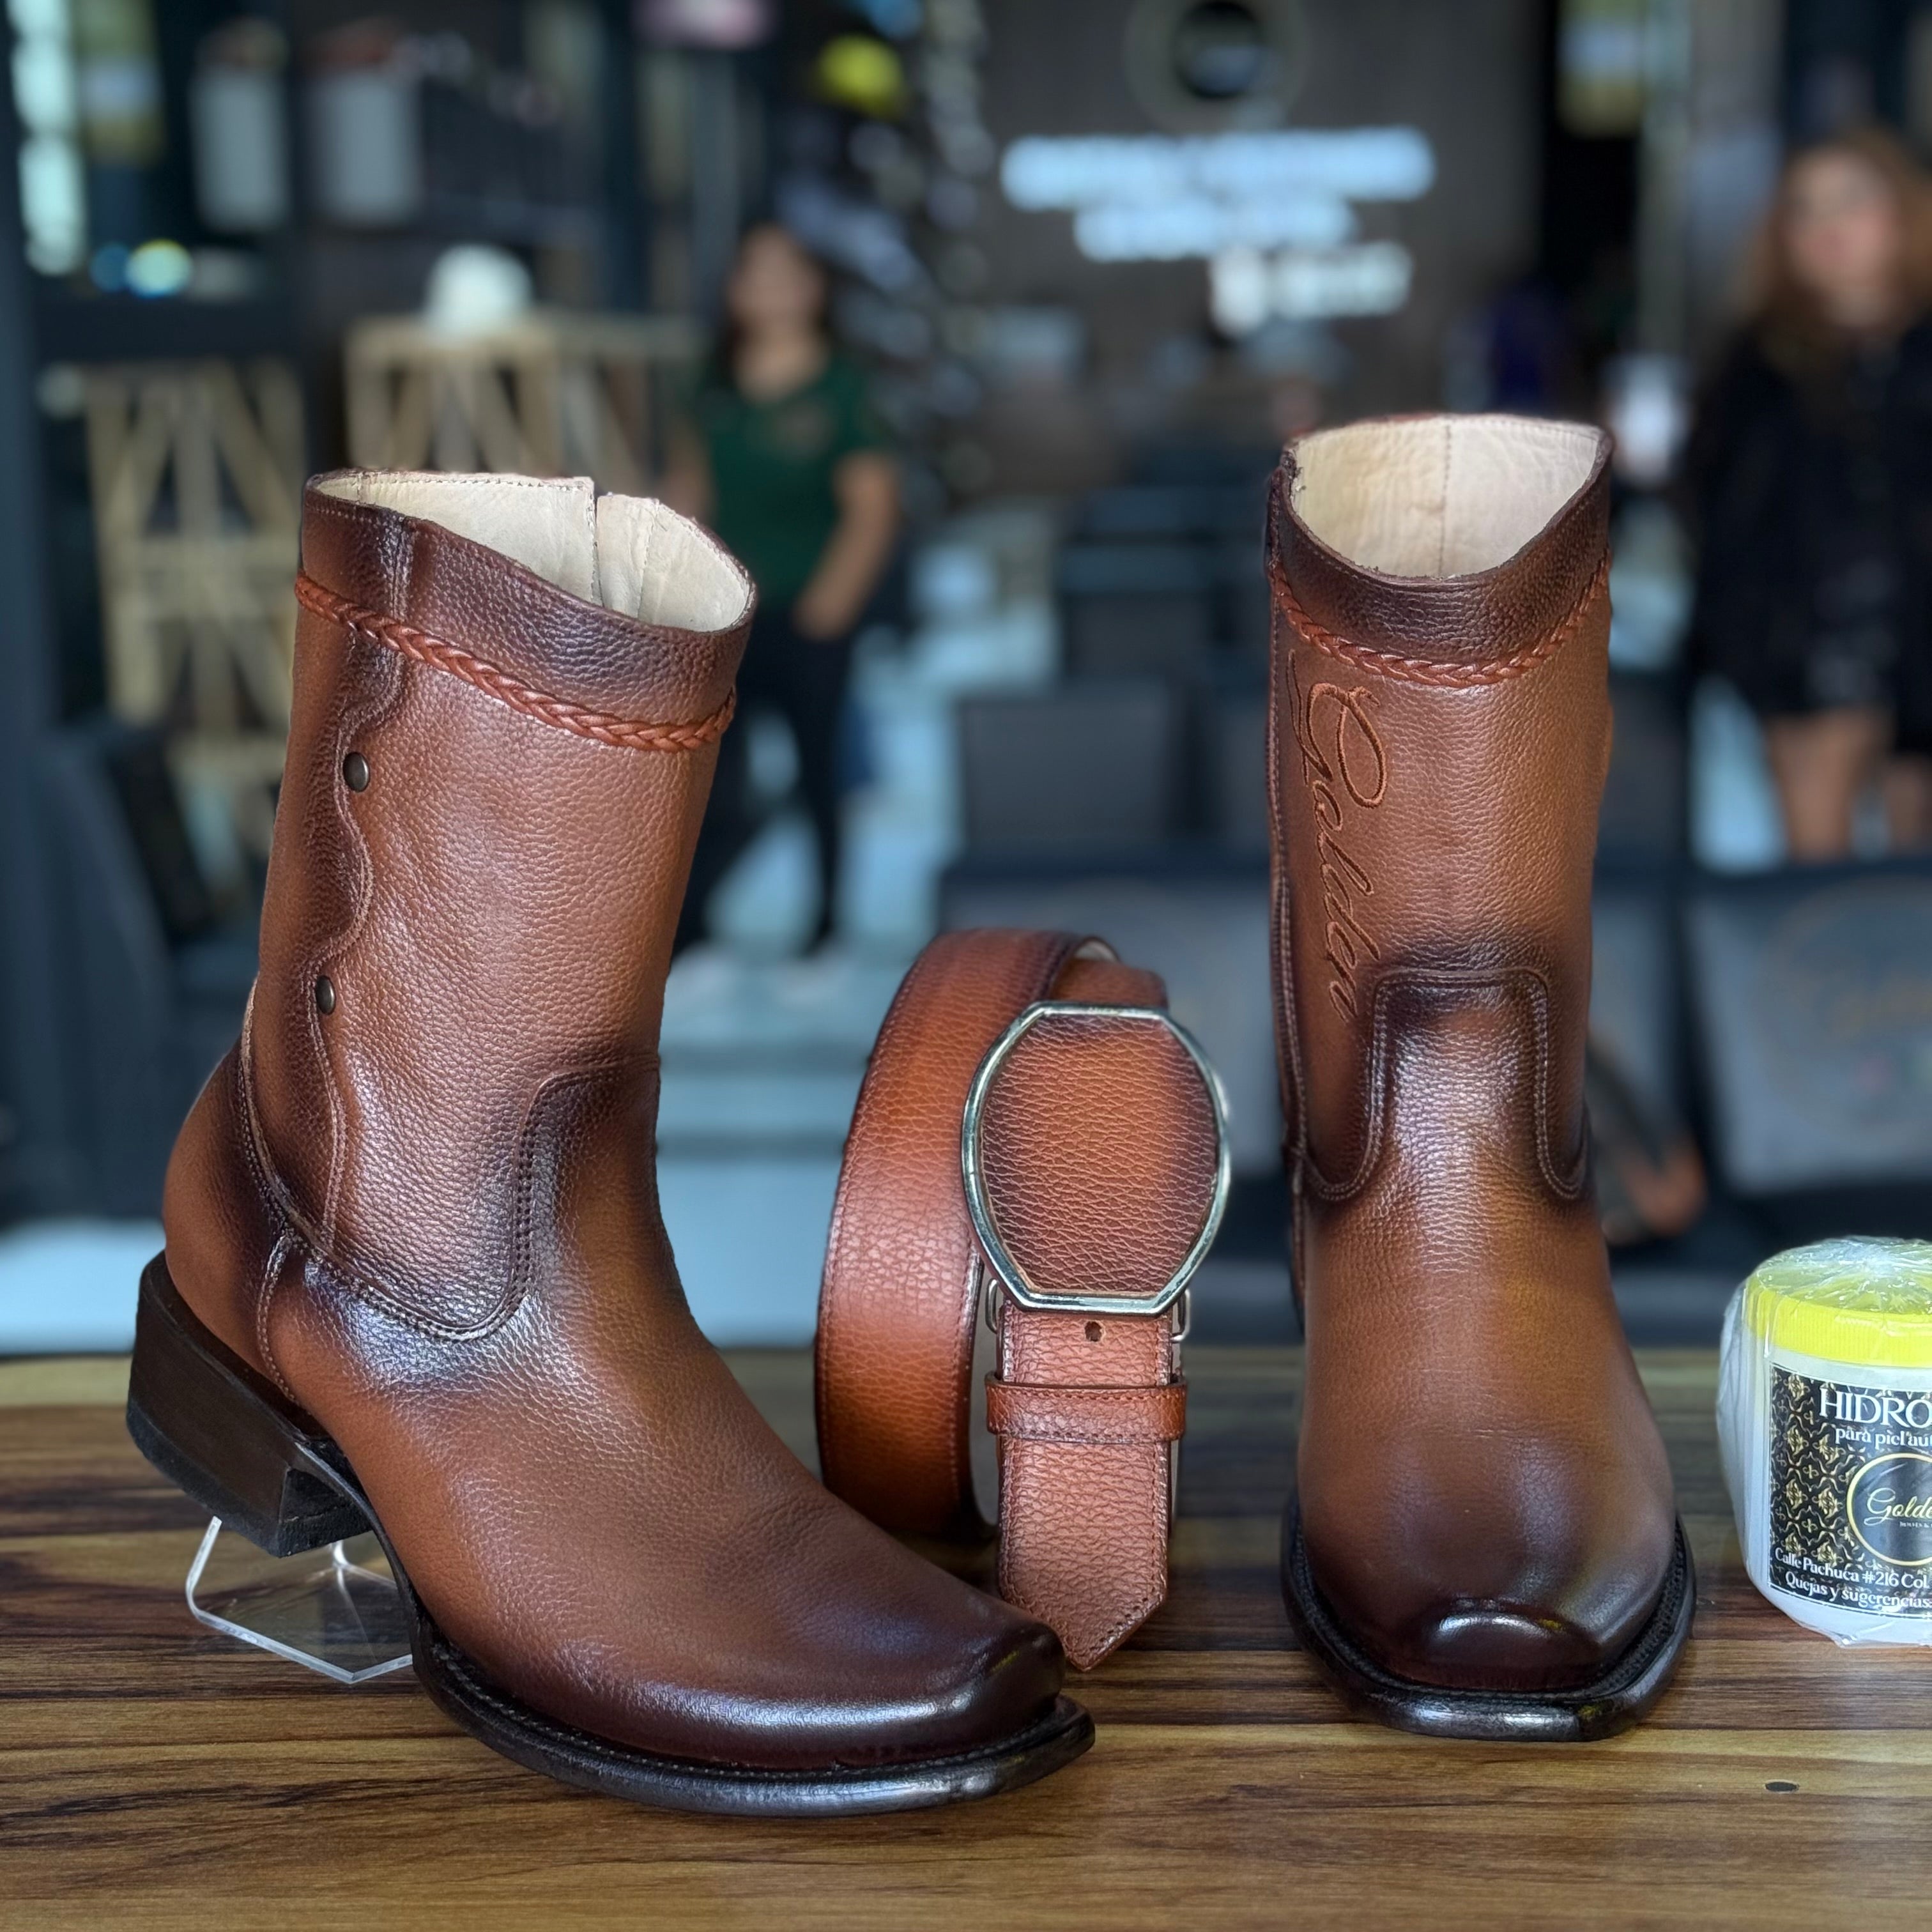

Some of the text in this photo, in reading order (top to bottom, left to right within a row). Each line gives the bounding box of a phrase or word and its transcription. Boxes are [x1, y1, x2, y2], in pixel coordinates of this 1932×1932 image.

[1286, 649, 1387, 1023] Golden
[1820, 1388, 1932, 1429] HIDRO
[1835, 1427, 1871, 1445] para
[1874, 1430, 1906, 1450] piel
[1775, 1547, 1802, 1569] Calle
[1803, 1556, 1860, 1583] Pachuca
[1861, 1570, 1900, 1588] #216
[1785, 1570, 1828, 1597] Quejas
[1828, 1586, 1841, 1602] y
